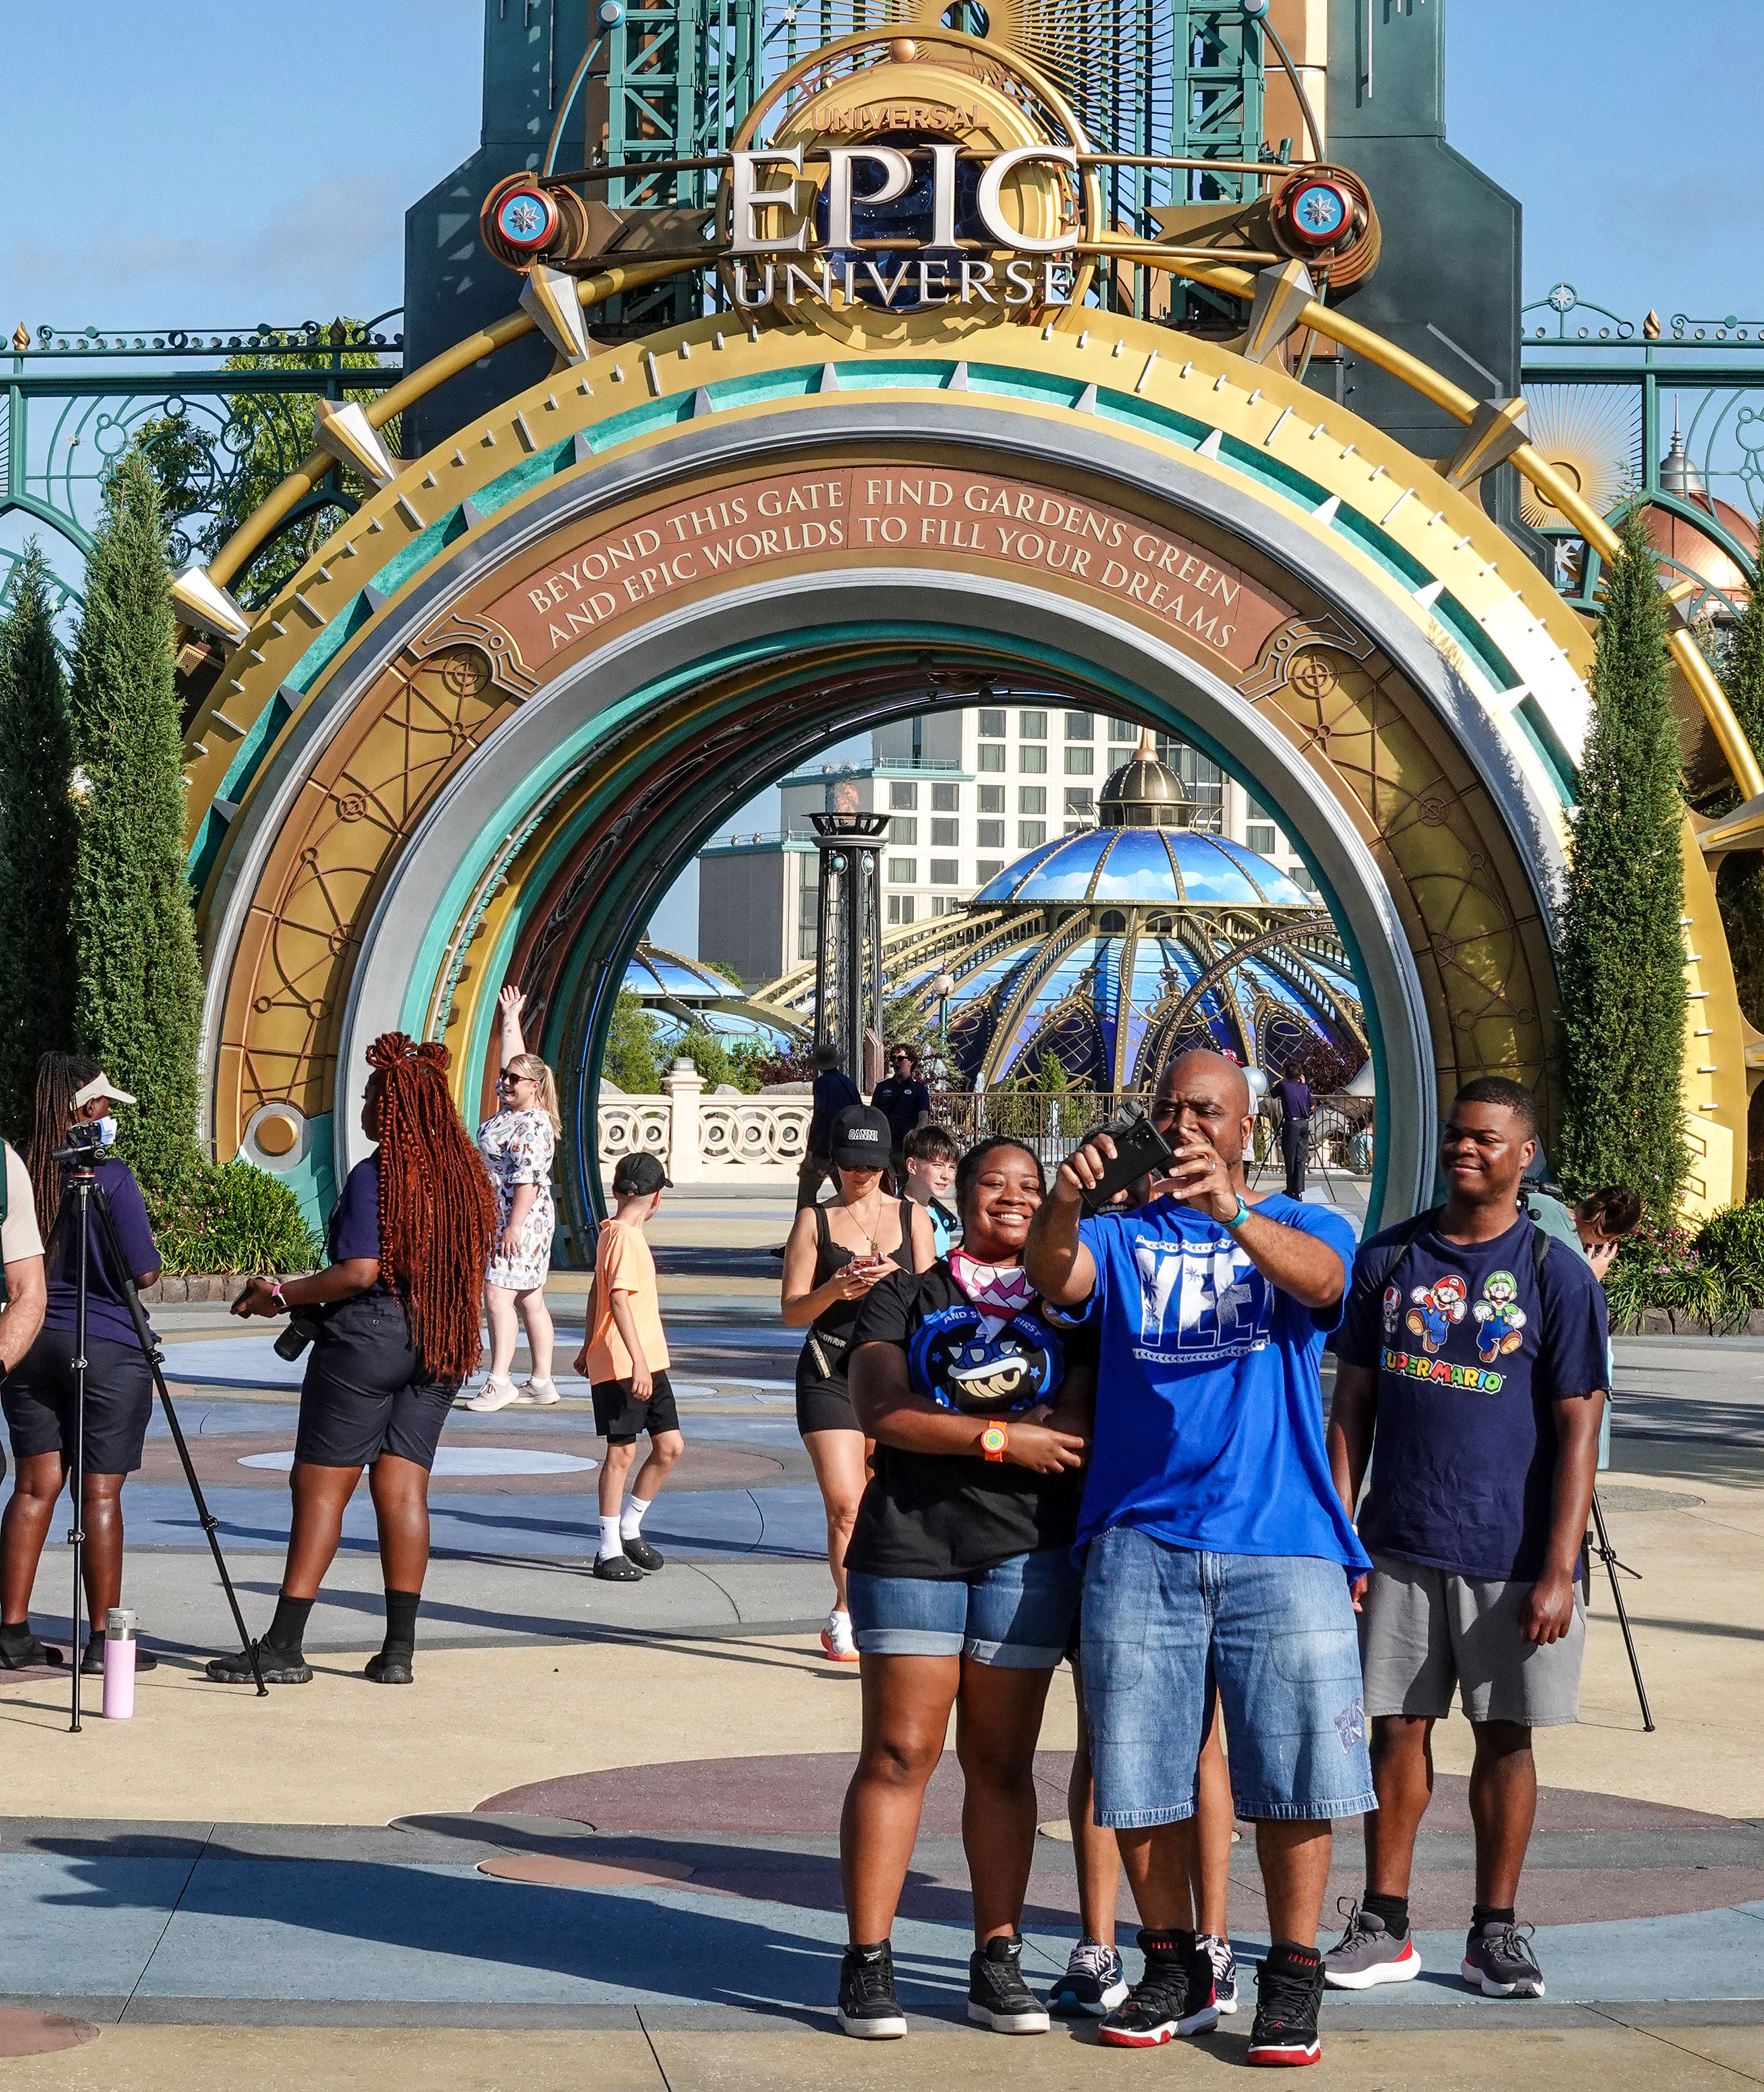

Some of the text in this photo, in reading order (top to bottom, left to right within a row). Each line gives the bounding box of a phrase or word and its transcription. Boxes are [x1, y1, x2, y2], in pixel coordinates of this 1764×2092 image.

[811, 105, 989, 131] UNIVERSAL
[722, 142, 1080, 254] EPIC
[735, 260, 1074, 307] UNIVERSE
[527, 480, 1243, 615] BEYOND THIS GATE FIND GARDENS GREEN
[549, 516, 1237, 650] AND EPIC WORLDS TO FILL YOUR DREAMS
[1232, 950, 1245, 962] THE
[848, 1129, 878, 1142] GANNI
[944, 1311, 967, 1325] AND
[1013, 1317, 1042, 1337] FIRST
[1380, 1347, 1501, 1392] SUPER MARIO
